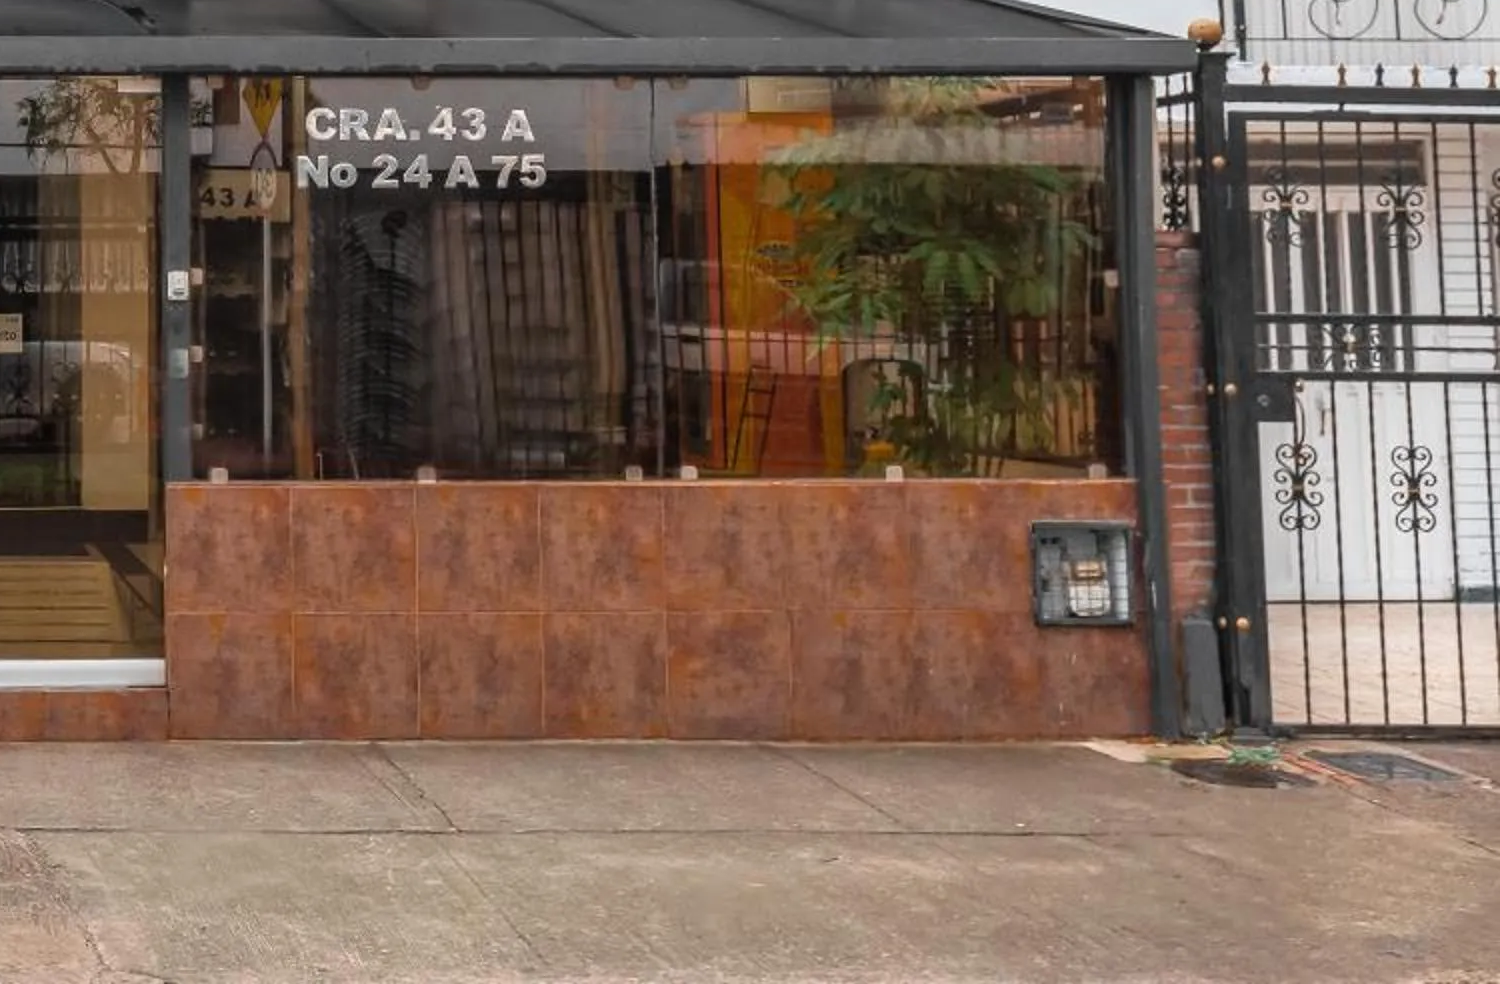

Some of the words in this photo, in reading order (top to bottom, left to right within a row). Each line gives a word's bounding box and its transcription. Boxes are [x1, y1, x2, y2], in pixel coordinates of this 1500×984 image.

[305, 107, 421, 141] CRA.
[428, 106, 488, 142] 43
[501, 109, 536, 142] A
[296, 154, 358, 189] No
[371, 153, 433, 189] 24
[443, 155, 480, 189] A
[491, 153, 548, 189] 75
[201, 186, 235, 208] 43
